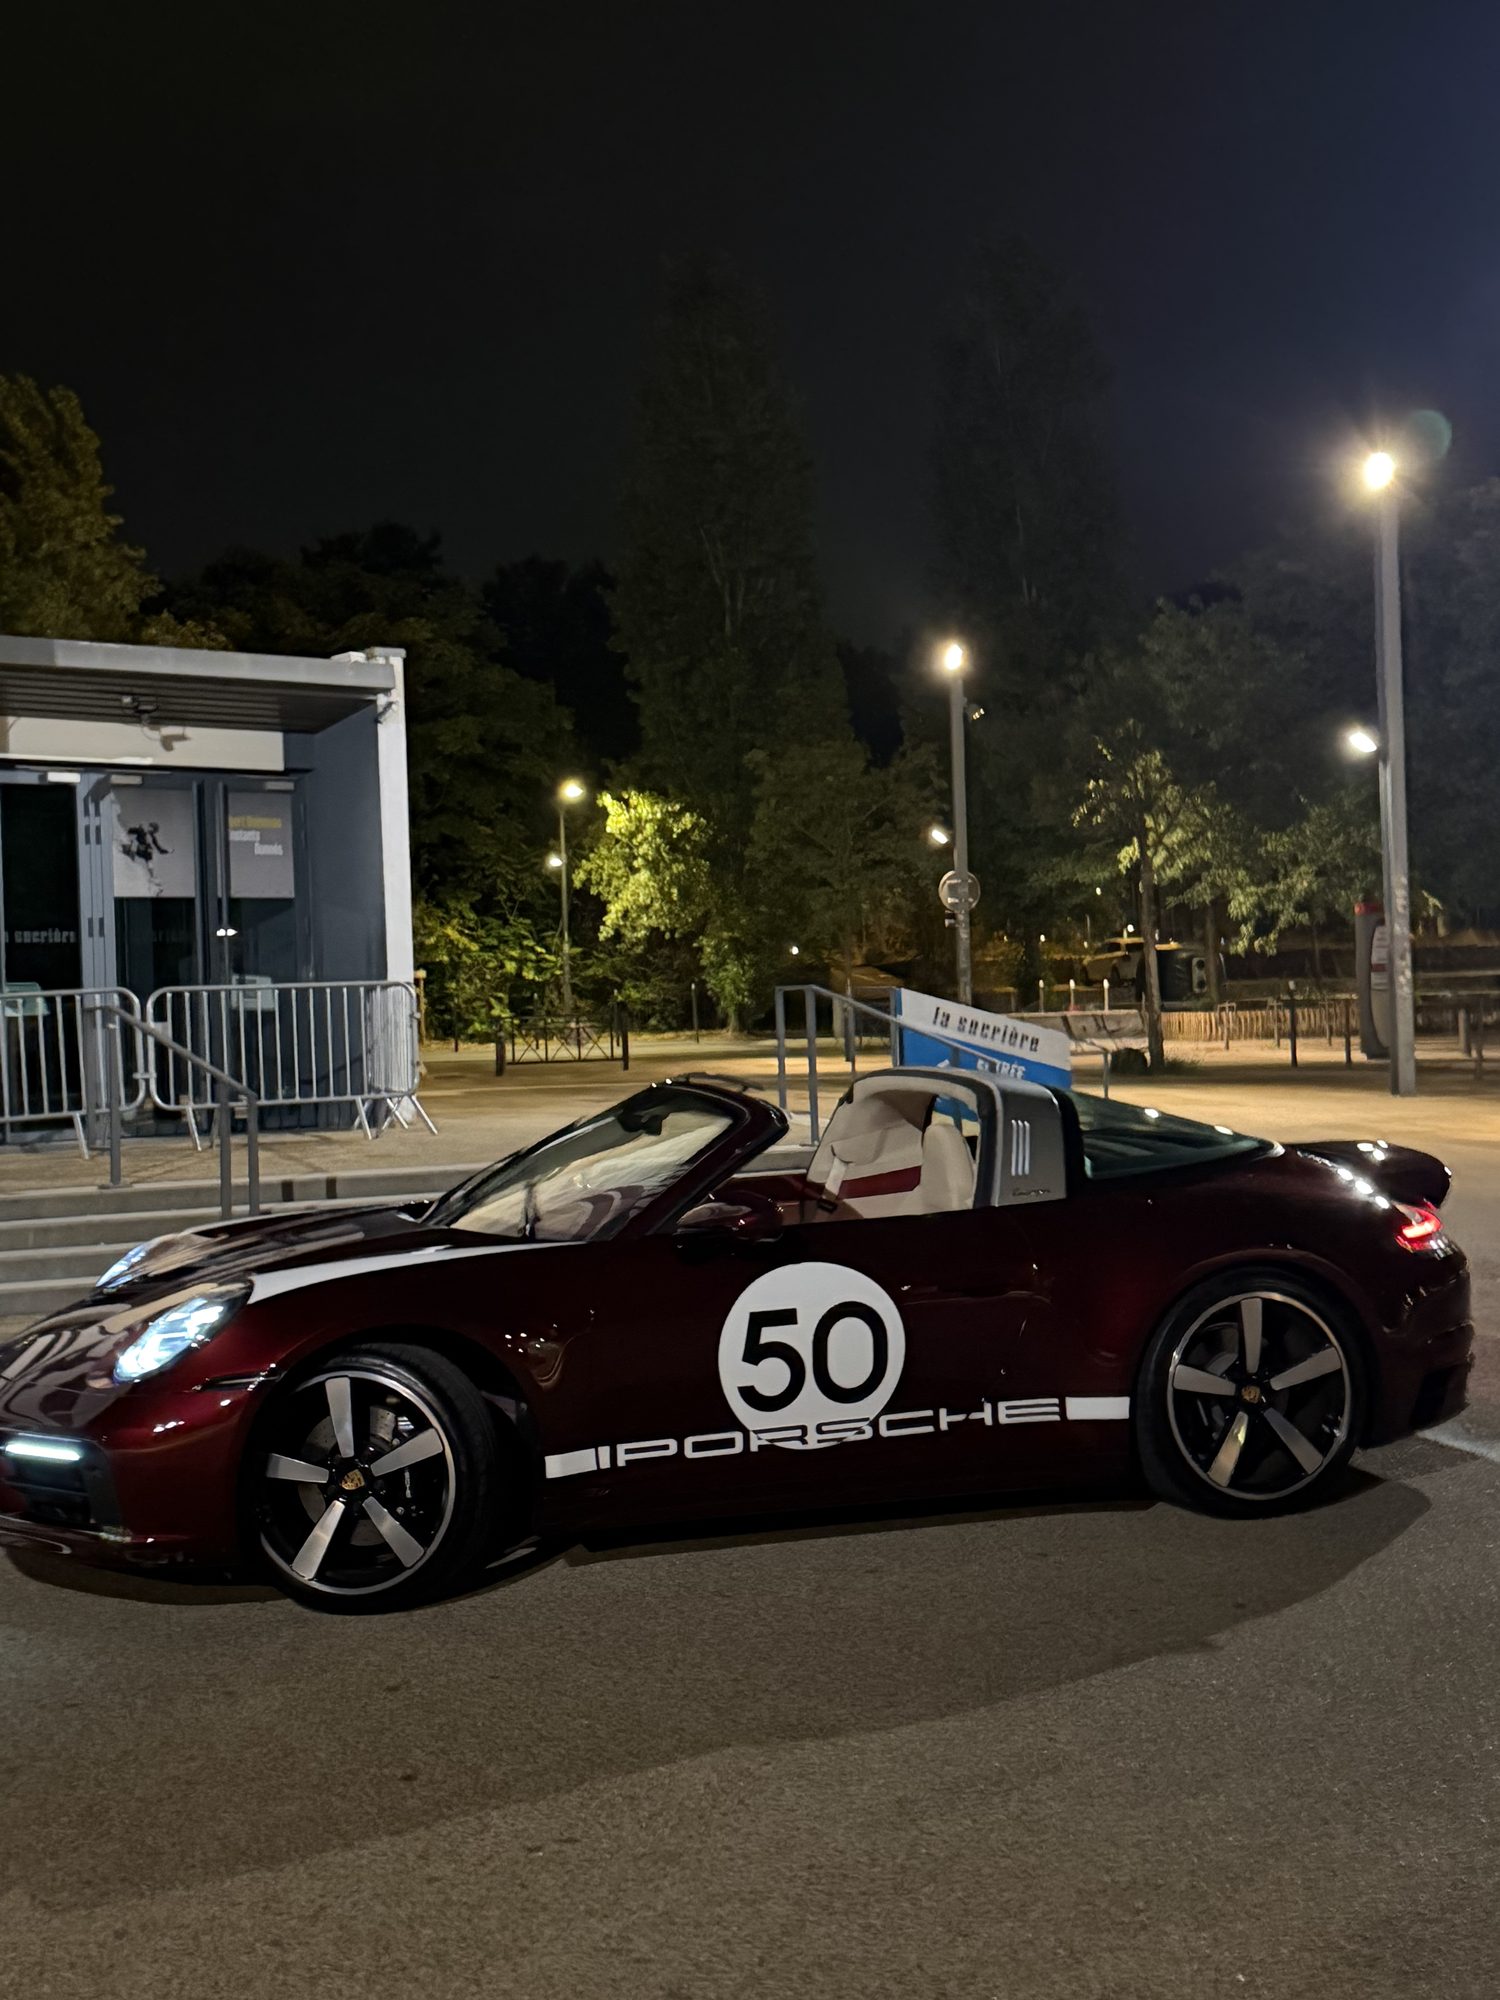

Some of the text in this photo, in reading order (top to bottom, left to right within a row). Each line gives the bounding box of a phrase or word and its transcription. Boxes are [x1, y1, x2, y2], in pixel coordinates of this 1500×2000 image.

[932, 1006, 950, 1028] la
[737, 1300, 889, 1412] 50
[616, 1397, 1061, 1467] PORSCHE
